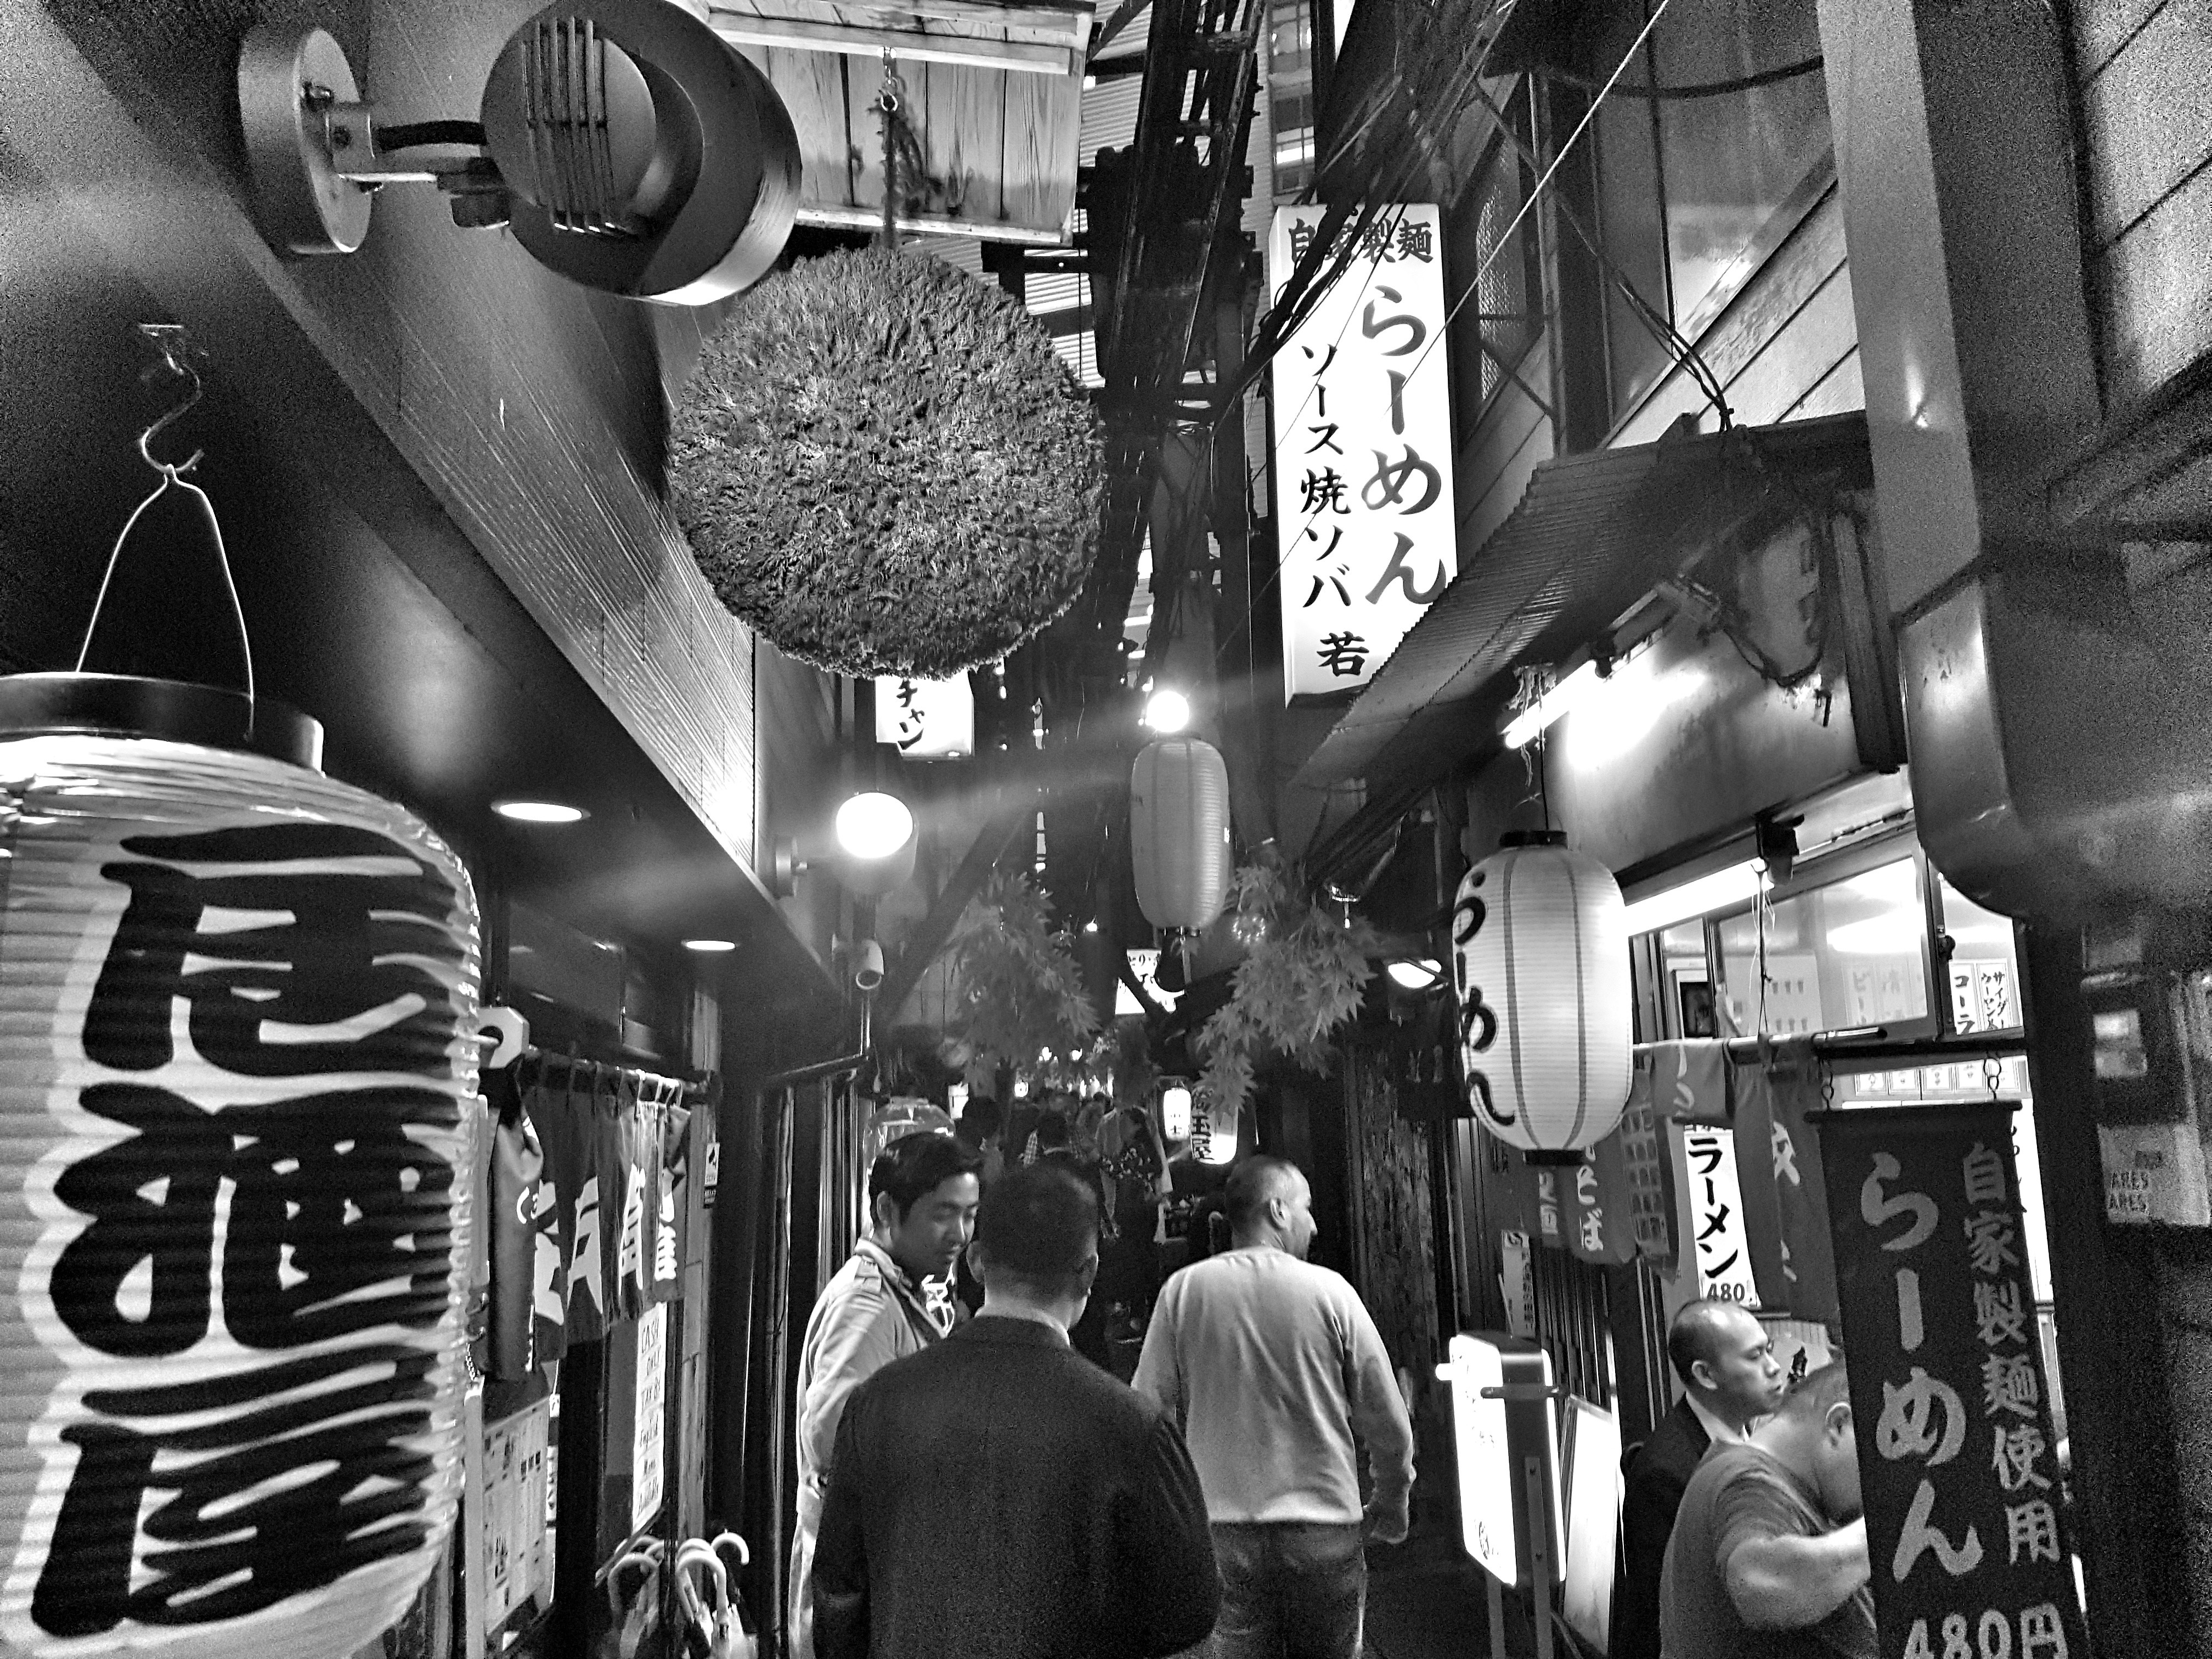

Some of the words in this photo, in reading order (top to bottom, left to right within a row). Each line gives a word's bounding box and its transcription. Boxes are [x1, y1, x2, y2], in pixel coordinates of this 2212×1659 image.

[1300, 343, 1352, 609] ソース焼ソバ
[1361, 284, 1446, 606] らーめん
[1954, 975, 1976, 1034] コーラ
[31, 822, 462, 1638] 居酒屋
[1688, 1137, 1739, 1279] ラーメン
[1707, 1282, 1746, 1302] 480
[1860, 1151, 1984, 1583] らーめん
[1962, 1140, 2062, 1566] 自家製麺使用
[1905, 1602, 2069, 1659] 480円
